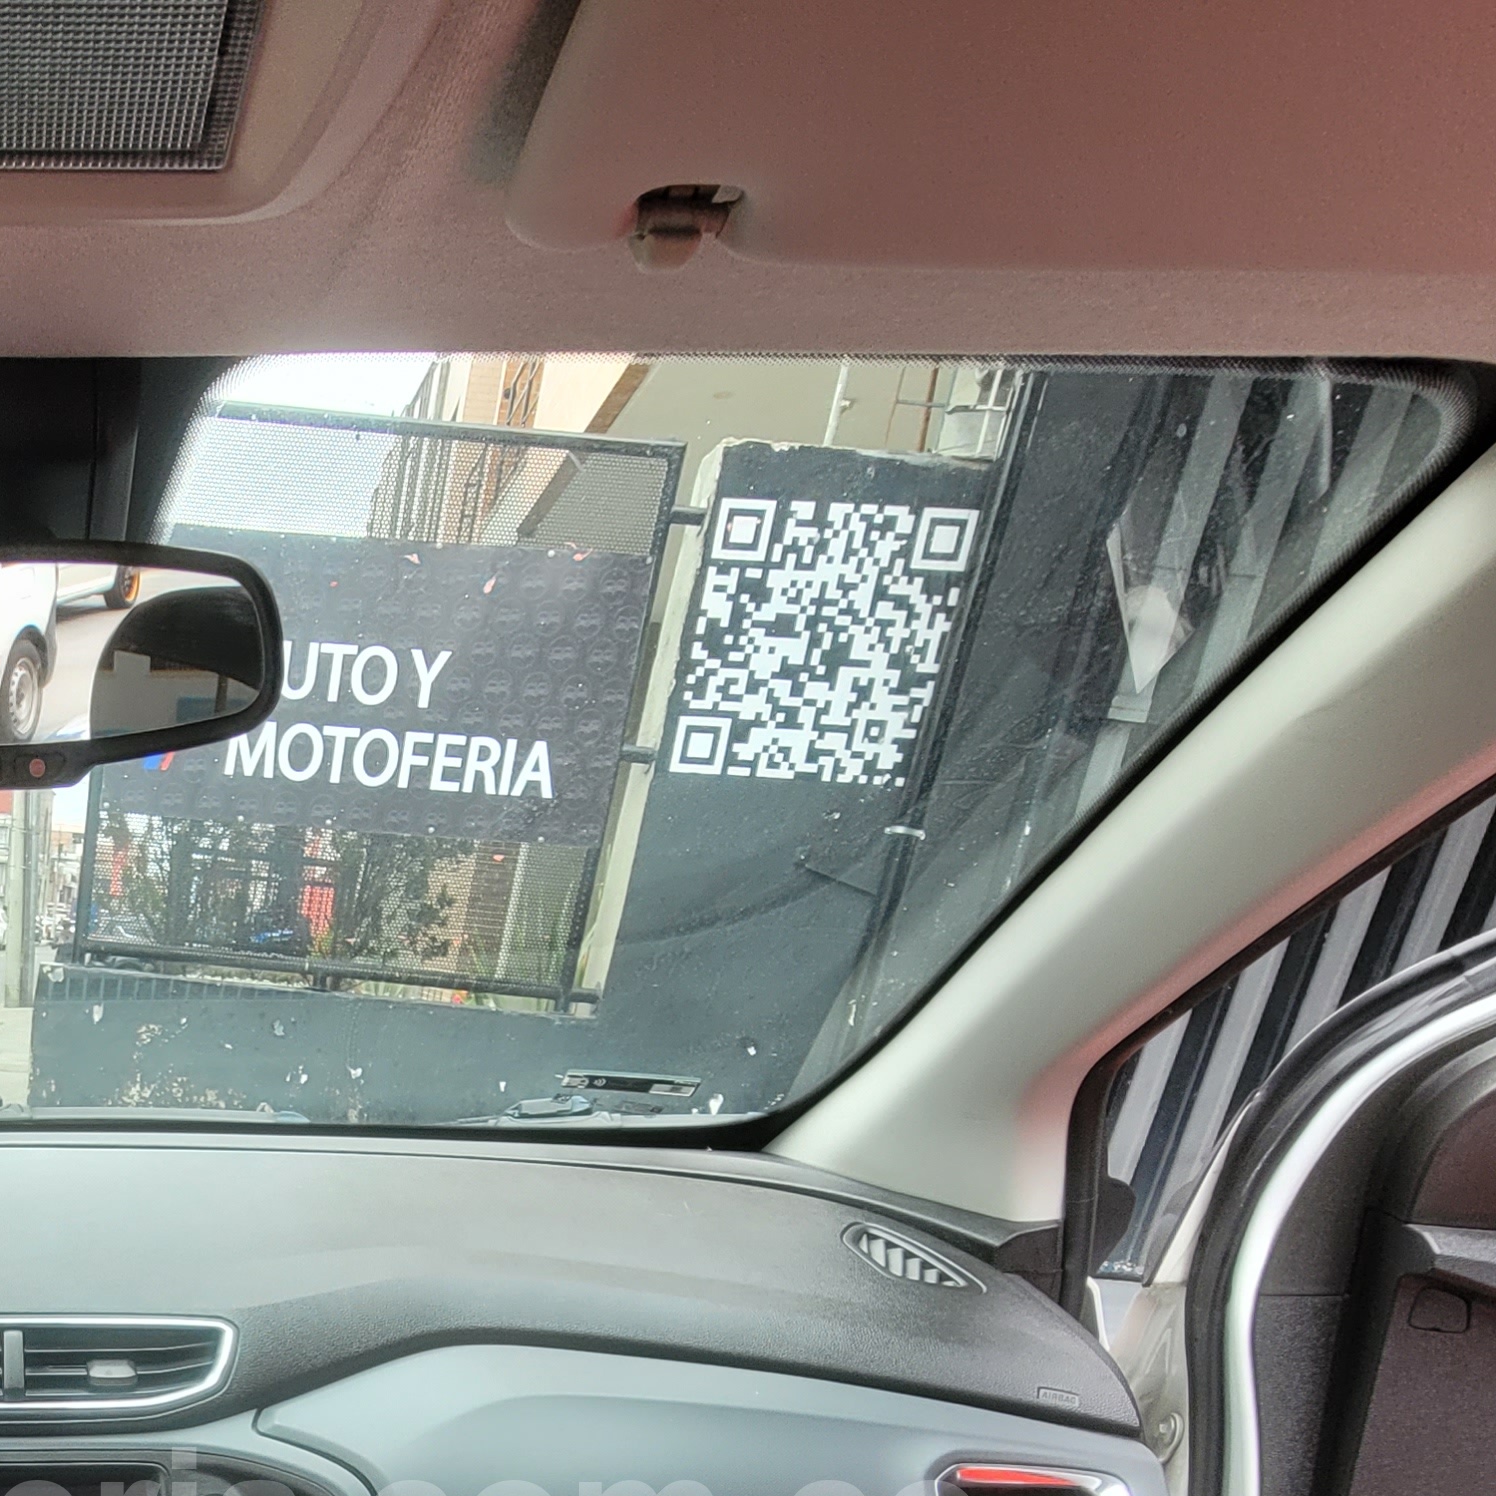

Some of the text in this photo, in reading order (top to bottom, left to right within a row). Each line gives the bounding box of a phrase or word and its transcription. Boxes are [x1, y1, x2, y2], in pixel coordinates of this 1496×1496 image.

[280, 640, 453, 708] UTO Y
[223, 720, 555, 800] MOTOFERIA
[1042, 1391, 1078, 1404] AIRBAG
